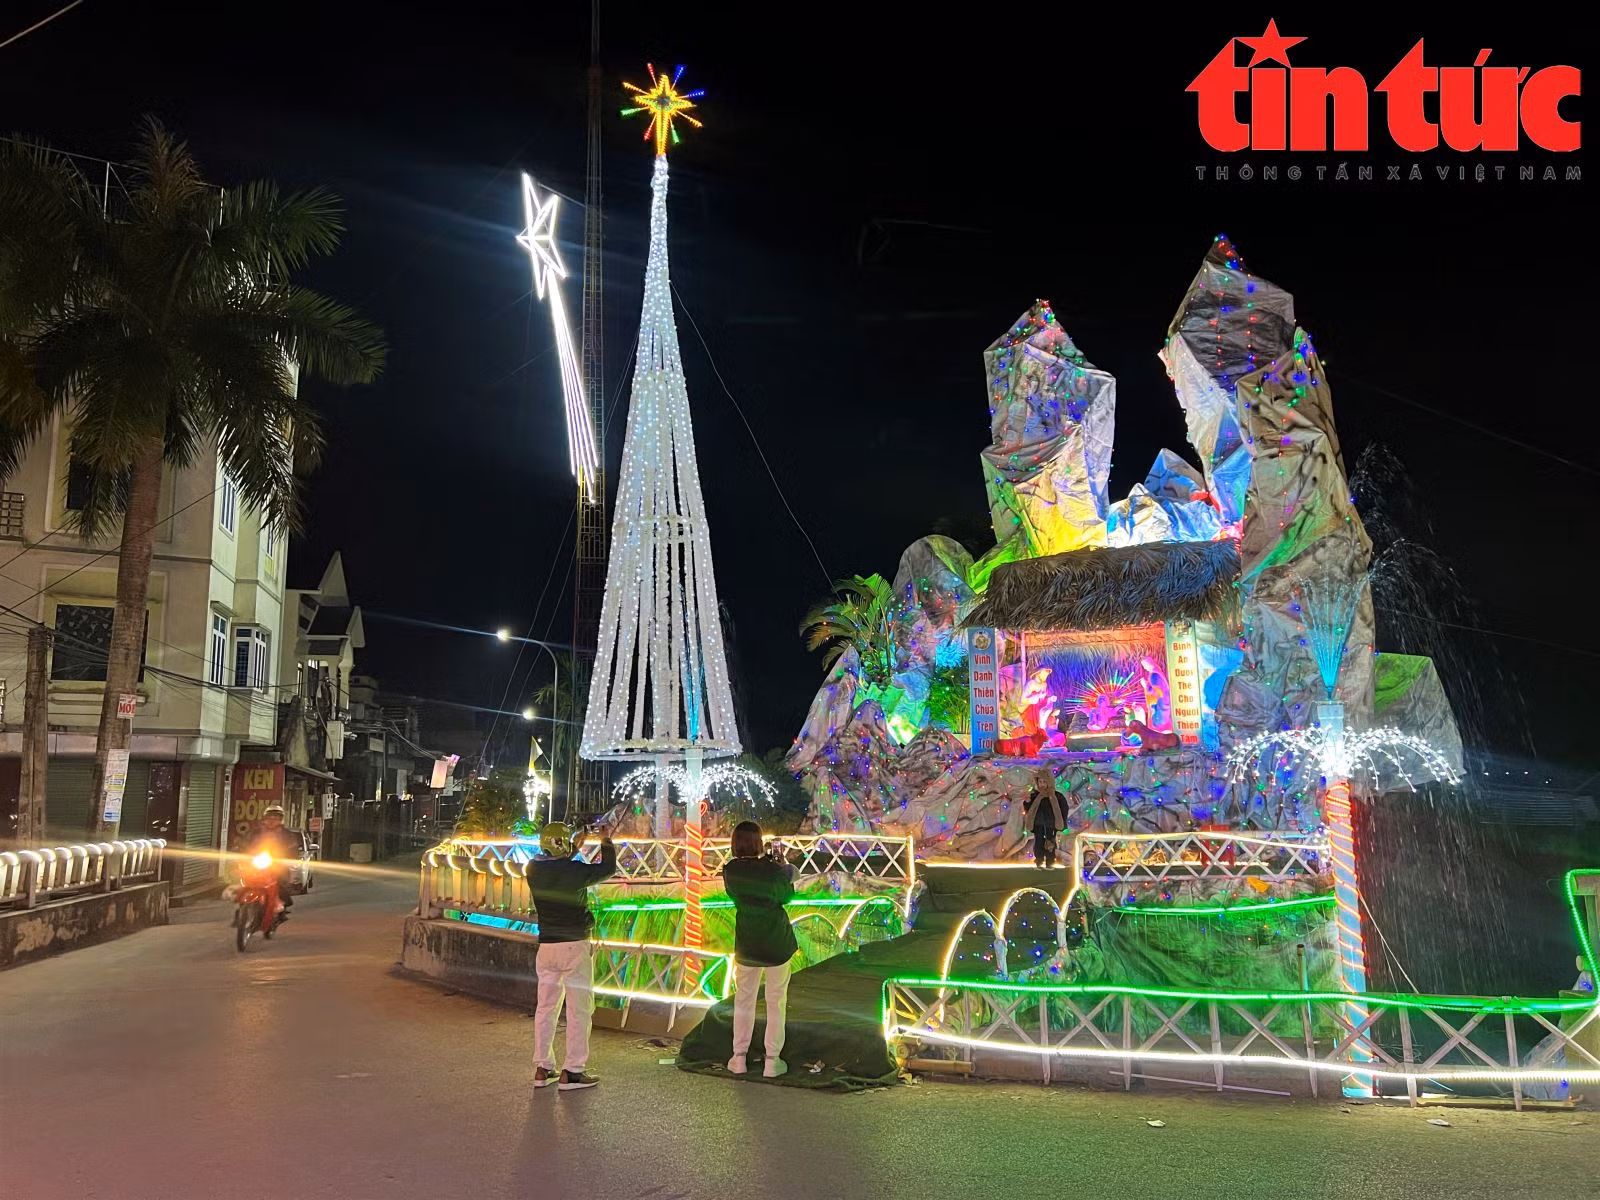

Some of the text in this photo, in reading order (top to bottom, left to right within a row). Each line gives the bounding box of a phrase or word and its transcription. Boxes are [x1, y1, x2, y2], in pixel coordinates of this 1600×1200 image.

[974, 653, 991, 665] Vinh
[1178, 655, 1189, 664] An
[973, 670, 993, 681] Danh
[1178, 694, 1194, 703] Cho
